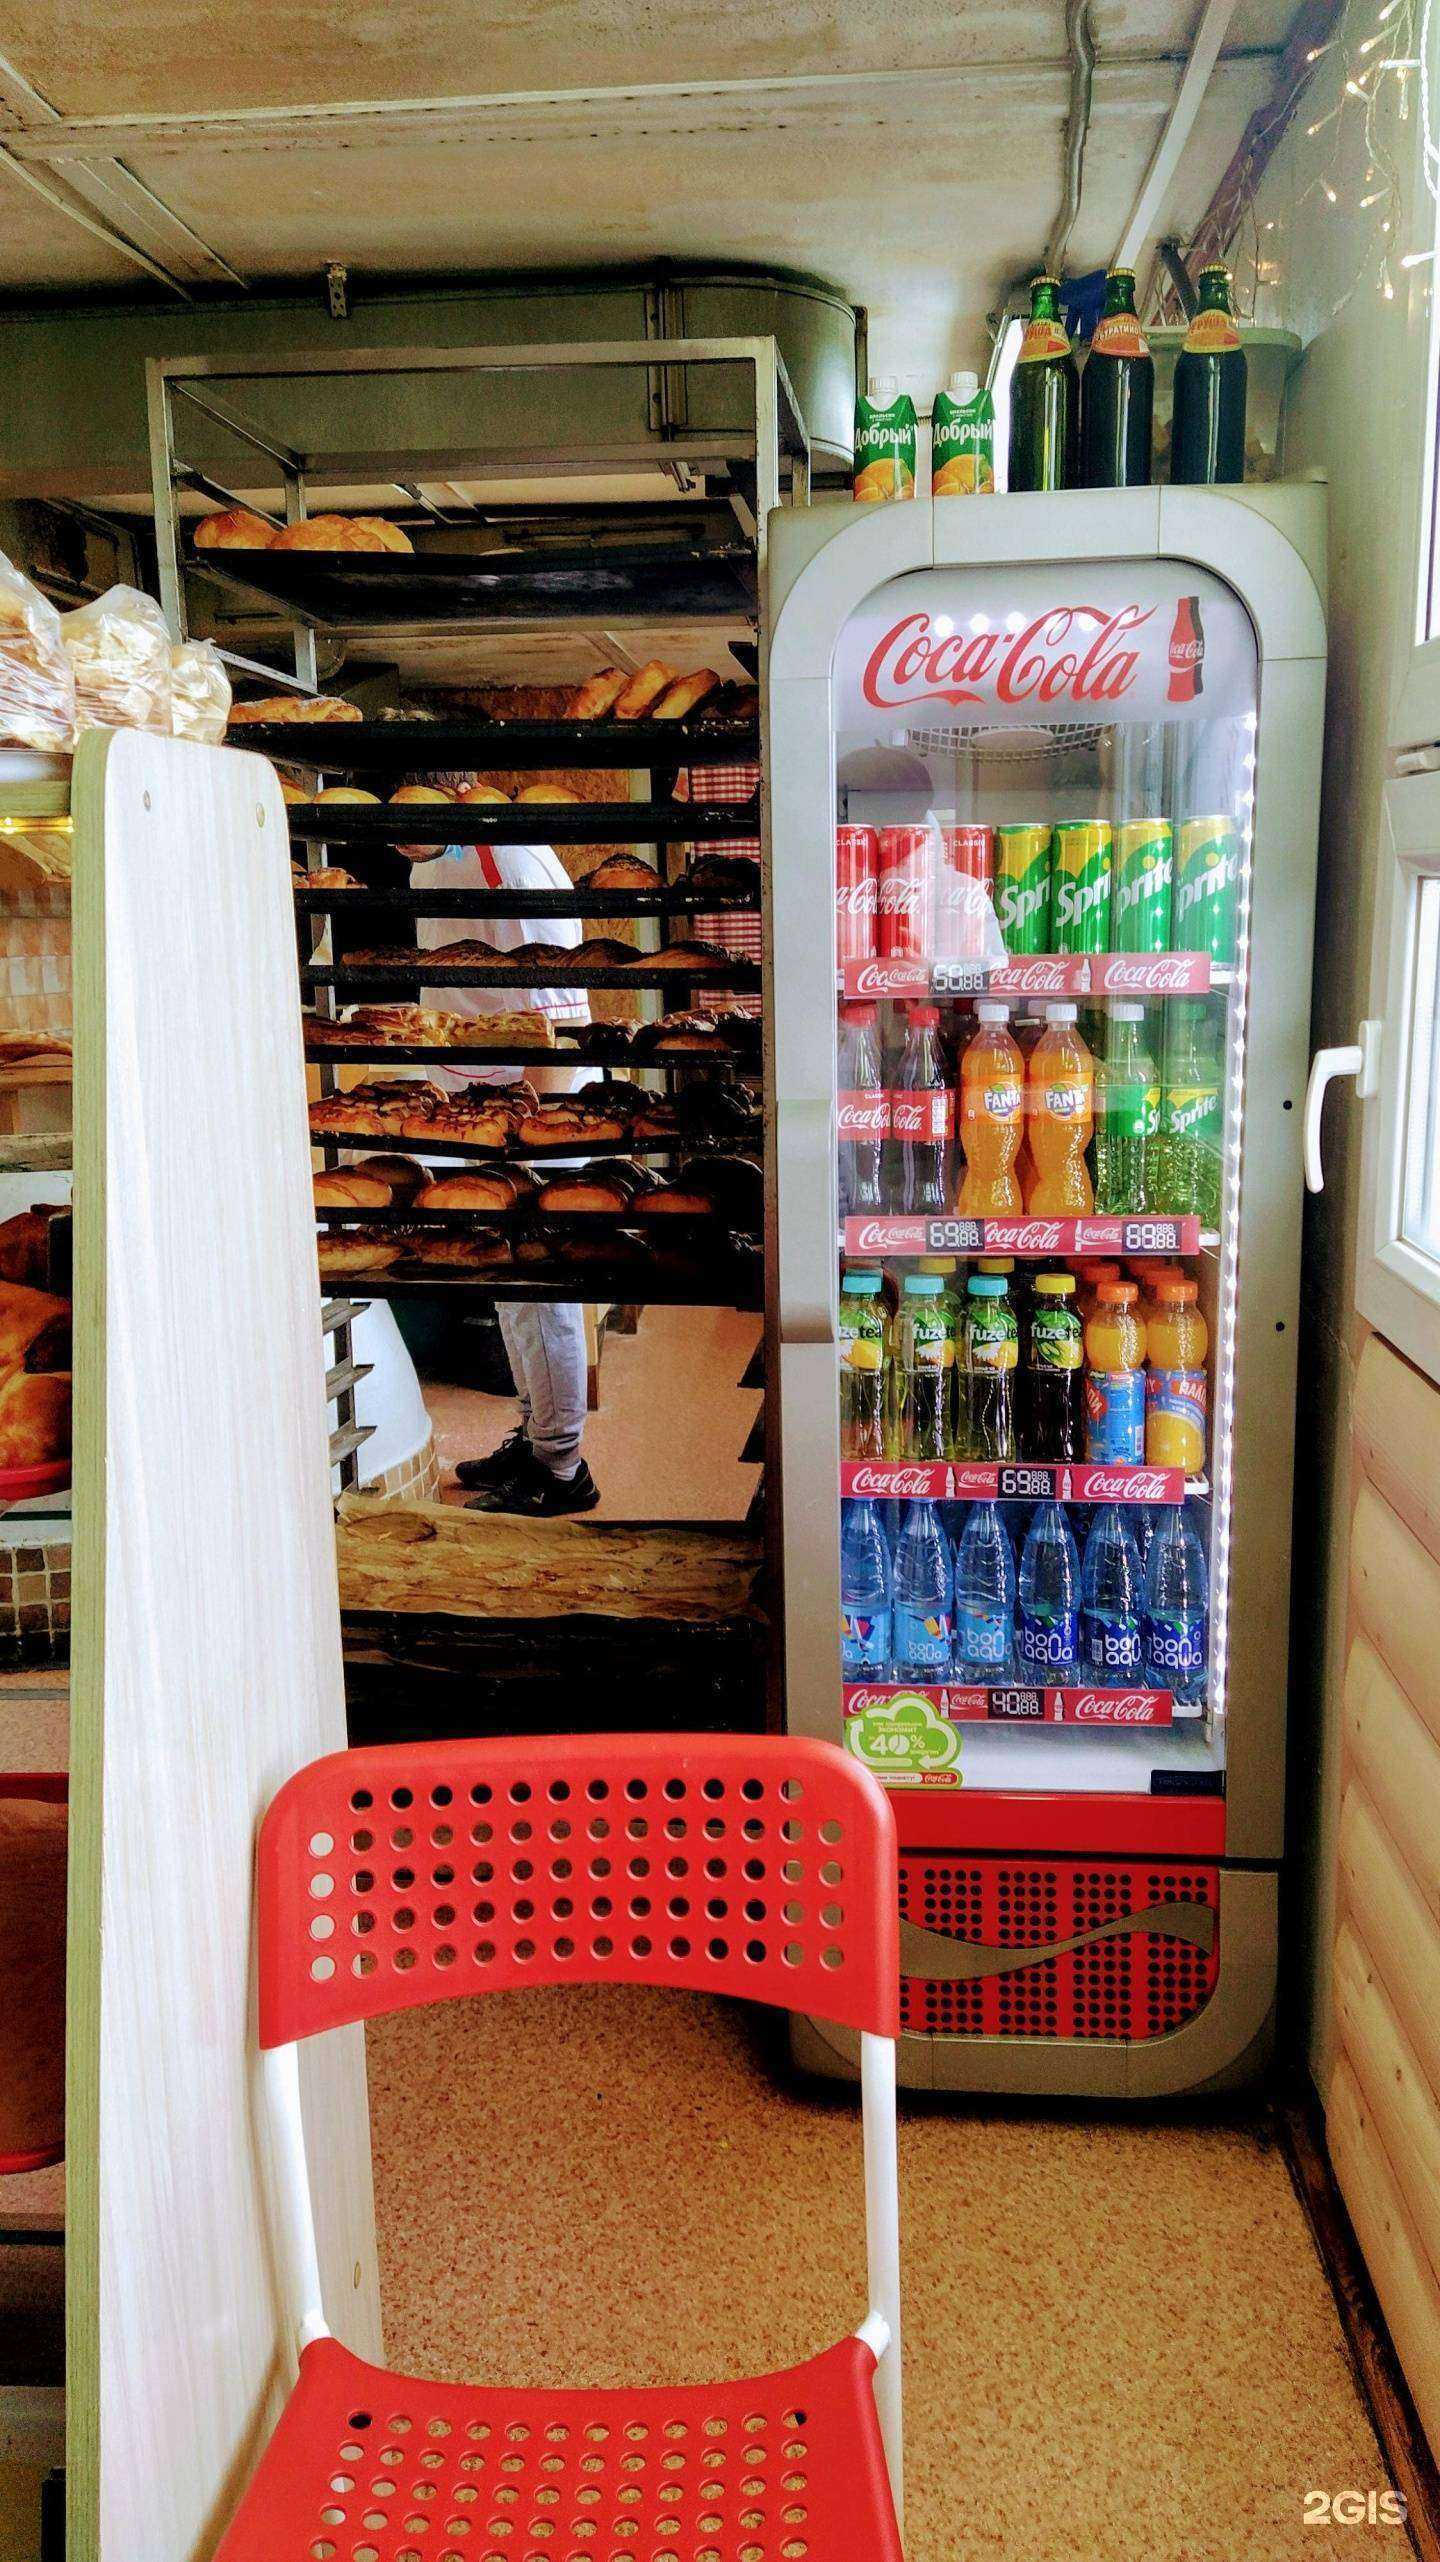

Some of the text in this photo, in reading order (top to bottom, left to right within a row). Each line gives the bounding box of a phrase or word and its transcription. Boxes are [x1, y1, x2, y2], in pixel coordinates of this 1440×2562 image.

[855, 422, 913, 451] Добрый
[933, 419, 992, 446] Добрый
[863, 603, 1158, 708] Coca-Cola
[989, 961, 1071, 991] oca-Cola
[1104, 959, 1195, 989] Coca-Cola
[1169, 1095, 1217, 1133] Sprite
[912, 1323, 946, 1340] fuze
[970, 1325, 1006, 1341] fuze
[1031, 1322, 1065, 1340] fuze
[852, 1467, 935, 1494] Coca-Cola
[1084, 1471, 1171, 1499] Coca-Cola
[967, 1627, 1005, 1650] bon
[1025, 1626, 1062, 1648] bon
[1105, 1633, 1141, 1651] bon
[1153, 1632, 1192, 1653] bon
[1025, 1645, 1074, 1664] aqua
[1153, 1650, 1203, 1670] aqua
[1075, 1694, 1159, 1721] Coca-Cola
